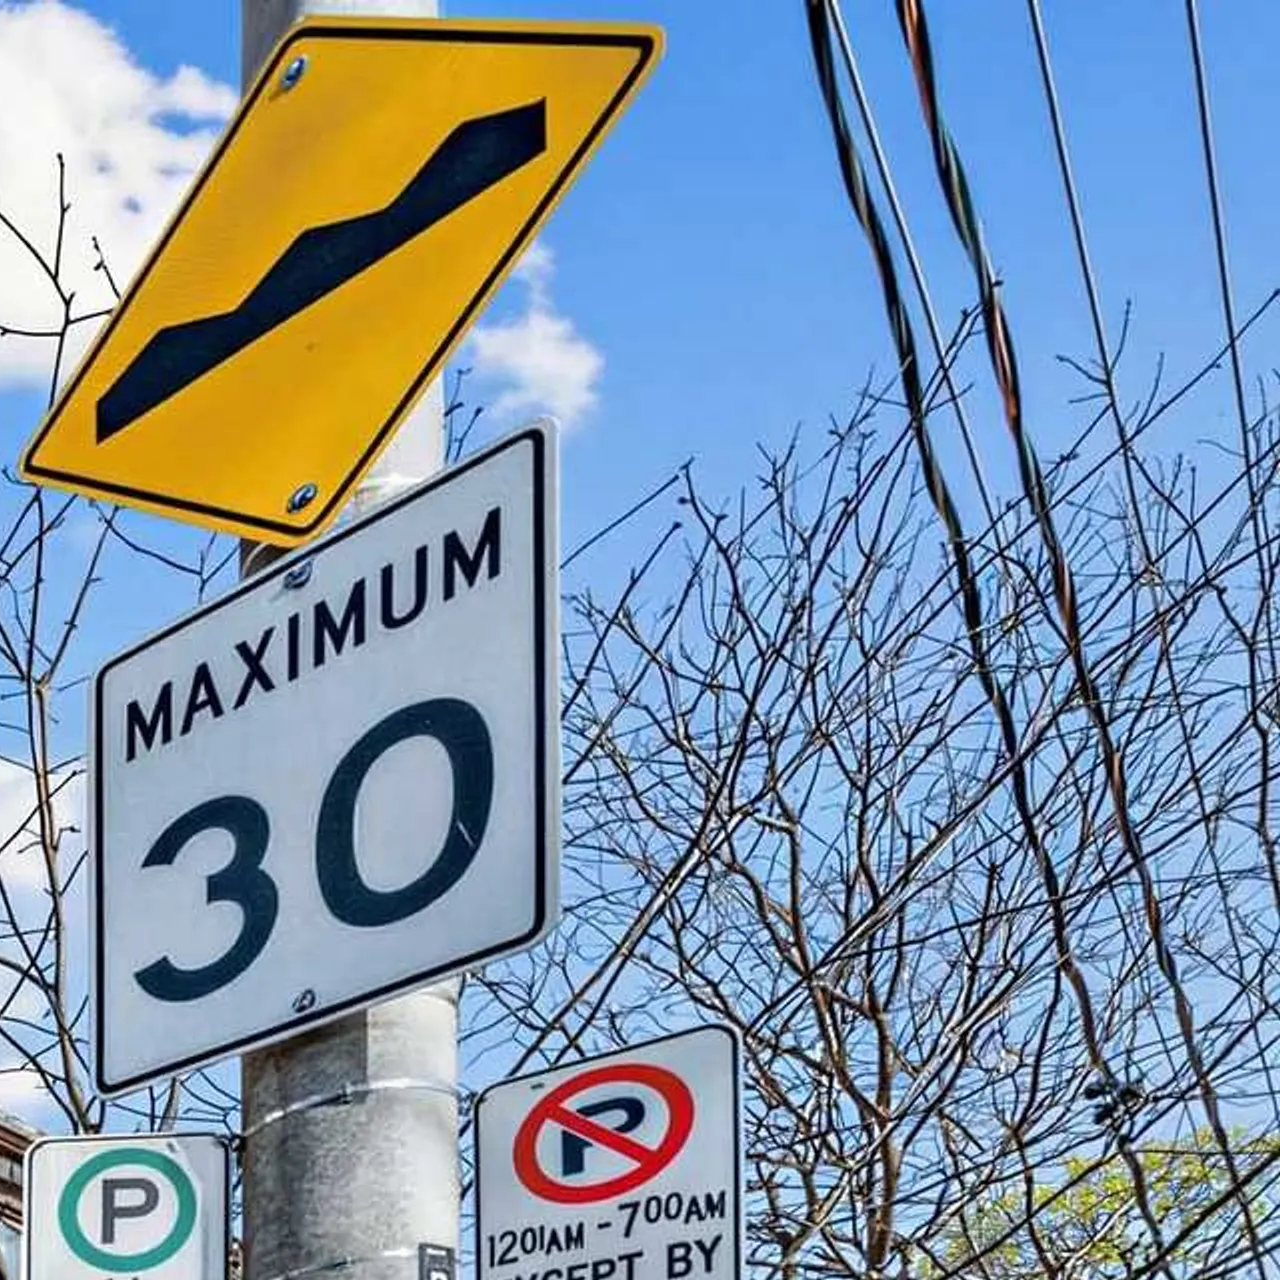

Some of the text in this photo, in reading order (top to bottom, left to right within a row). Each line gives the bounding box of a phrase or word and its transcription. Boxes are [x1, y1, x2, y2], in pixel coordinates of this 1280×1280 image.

[125, 507, 503, 762] MAXIMUM
[132, 697, 495, 1002] 30
[101, 1178, 160, 1244] P
[666, 1234, 723, 1280] BY
